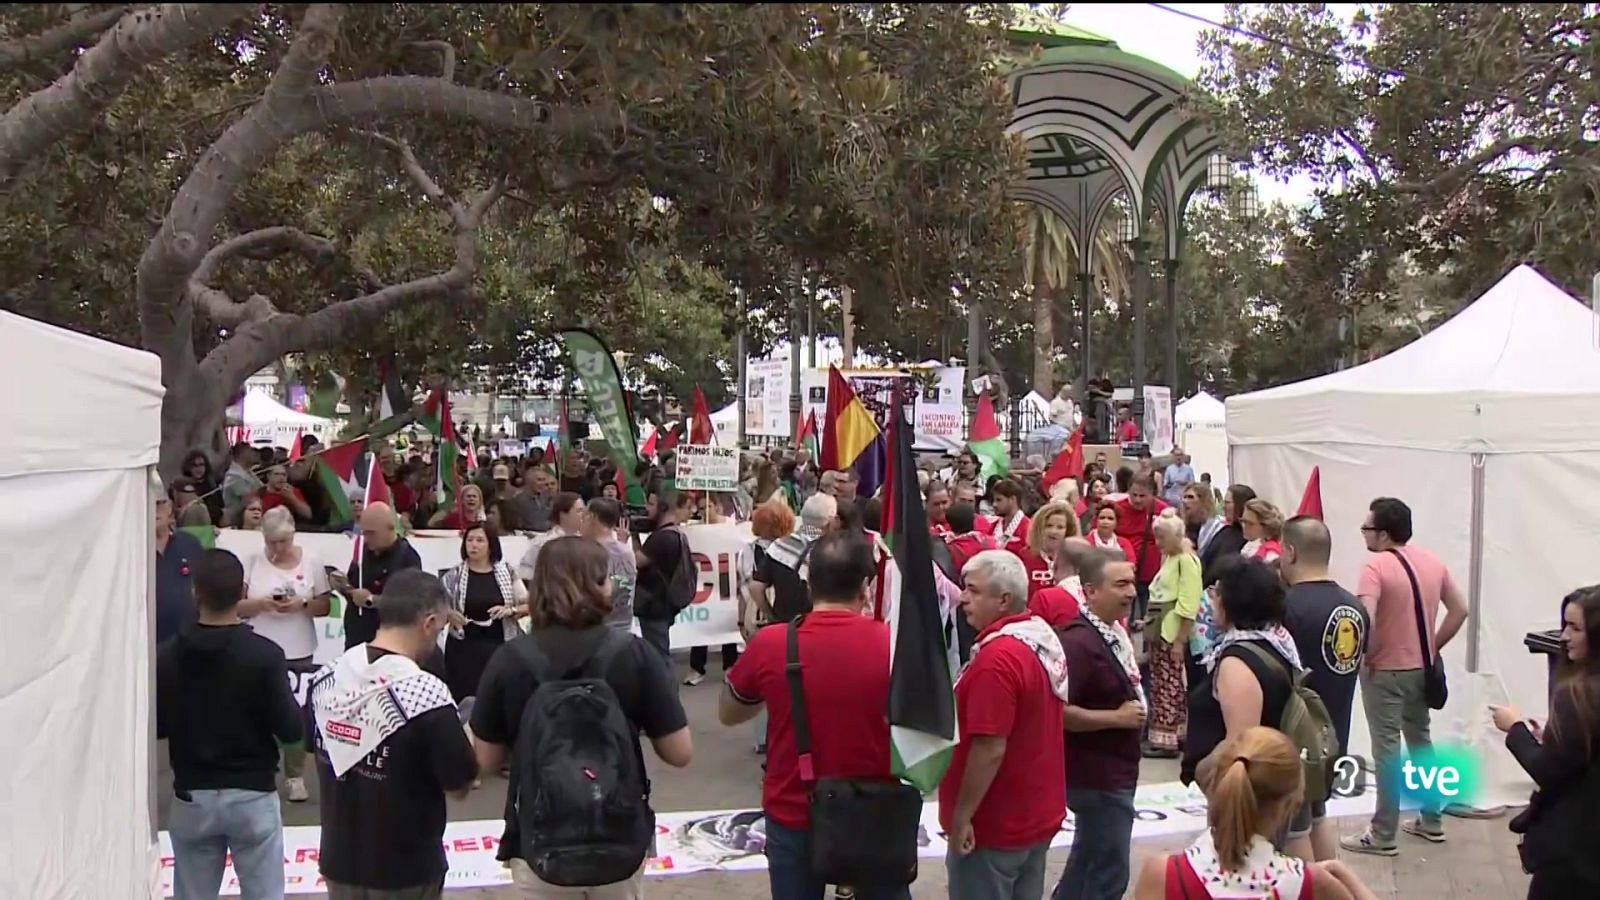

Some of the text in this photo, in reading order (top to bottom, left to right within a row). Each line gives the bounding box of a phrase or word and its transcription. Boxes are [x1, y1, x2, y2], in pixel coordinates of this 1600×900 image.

[921, 413, 956, 421] ENCUENTRO
[934, 420, 960, 428] CANARIA
[678, 446, 710, 456] PARIMOS
[678, 456, 689, 465] NO
[679, 607, 710, 622] NO
